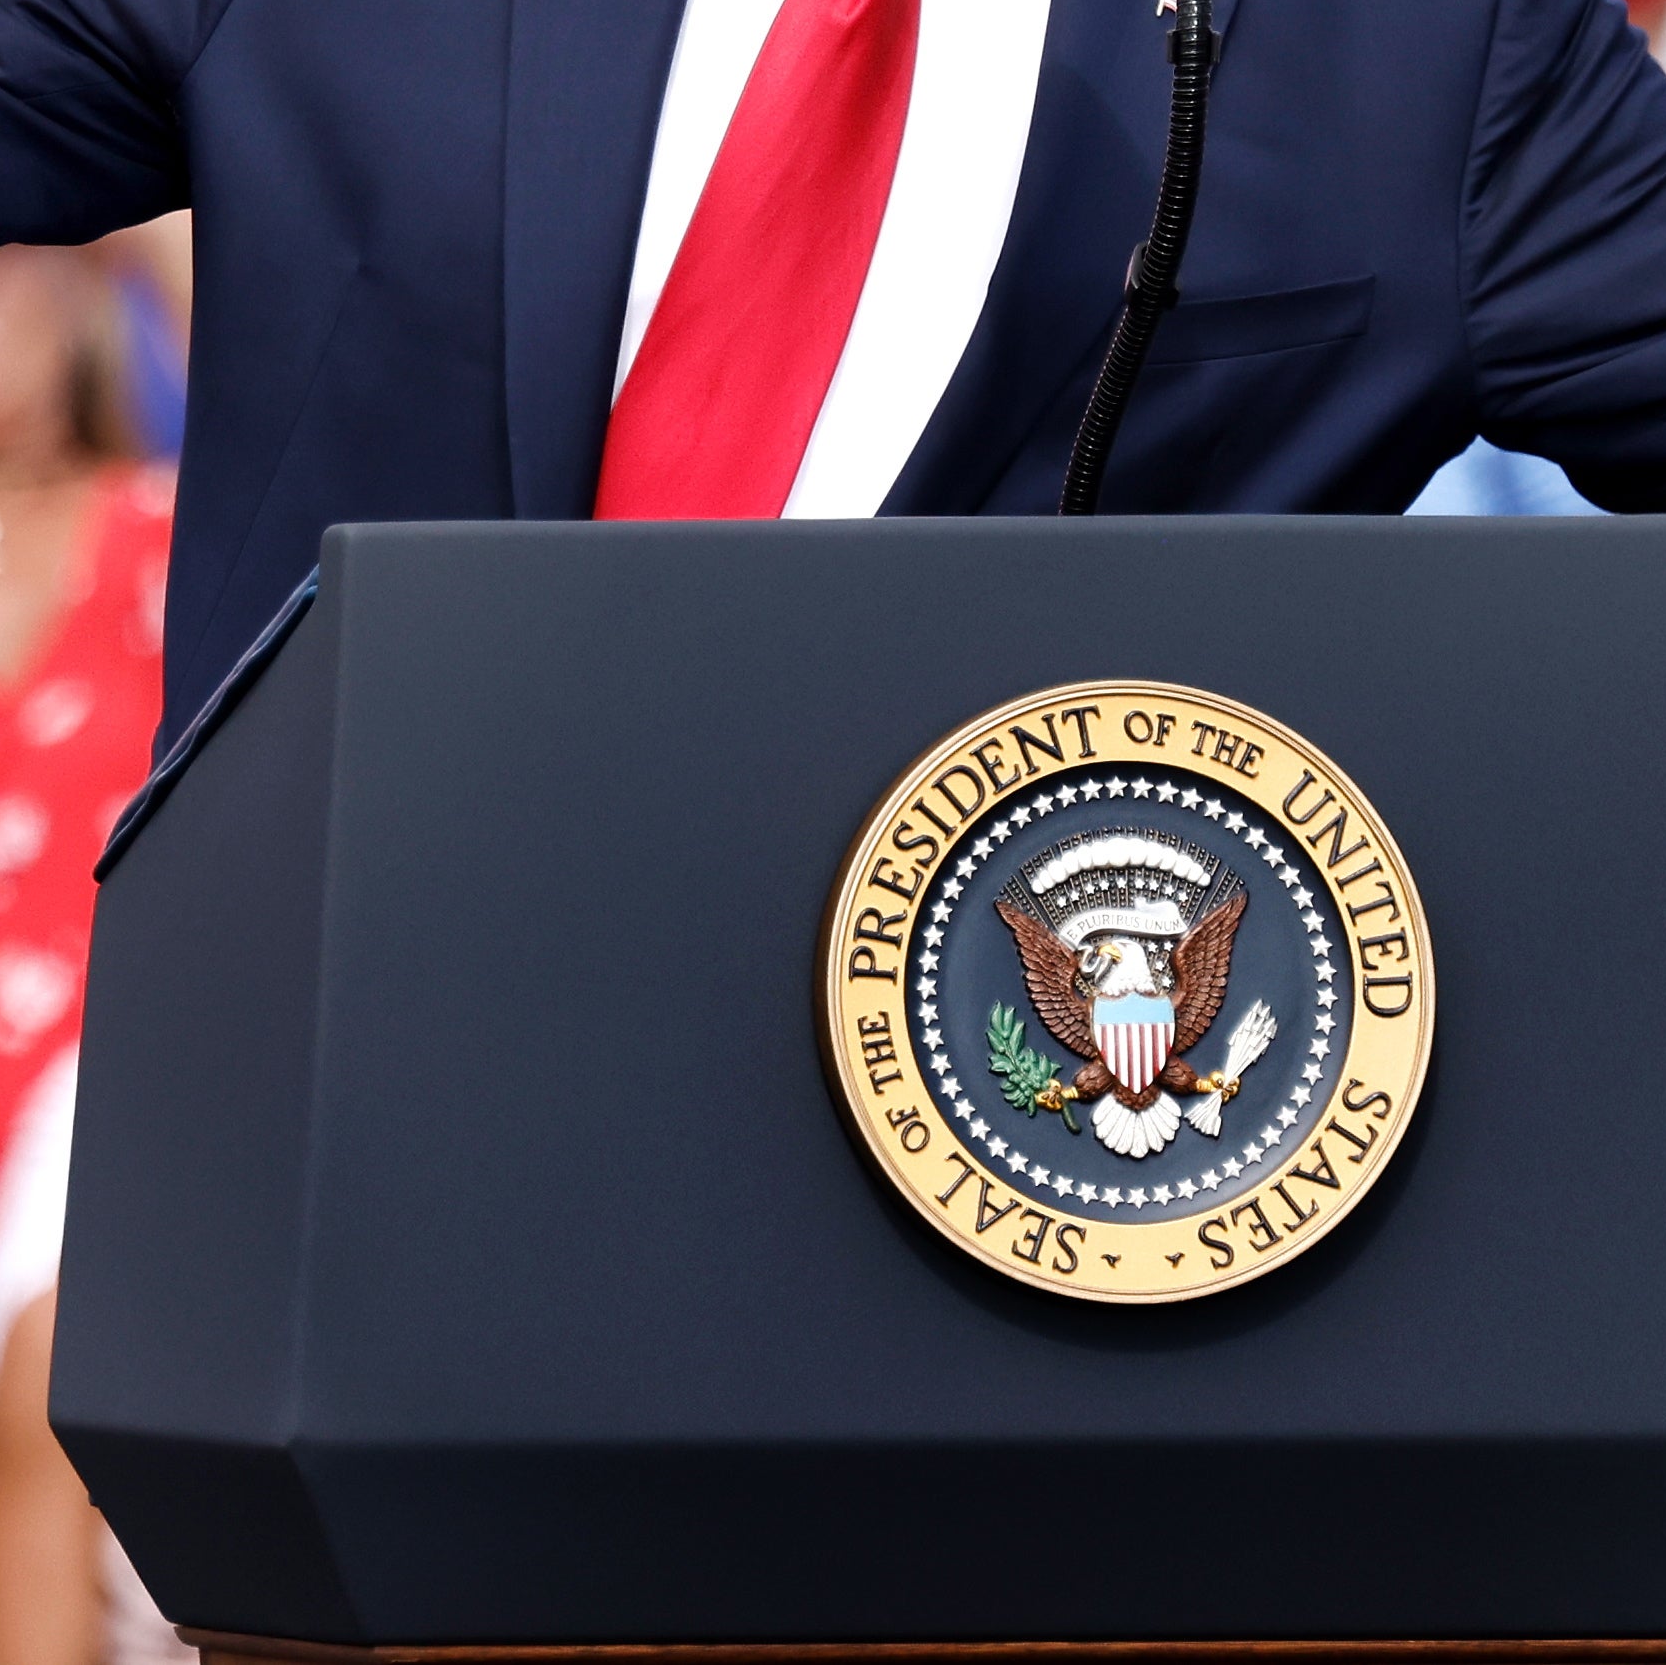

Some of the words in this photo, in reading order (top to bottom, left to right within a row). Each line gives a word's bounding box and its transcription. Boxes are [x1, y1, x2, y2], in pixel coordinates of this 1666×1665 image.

[1124, 710, 1176, 746] OF
[1191, 720, 1264, 778] THE
[850, 705, 1100, 982] PRESIDENT
[1078, 915, 1140, 932] PLURIBUS
[1145, 916, 1182, 930] UNUM
[1283, 770, 1412, 1016] UNITED
[864, 1011, 904, 1094] THE
[888, 1105, 930, 1151] OF
[937, 1151, 1087, 1273] SEAL
[1197, 1079, 1391, 1269] STATES
